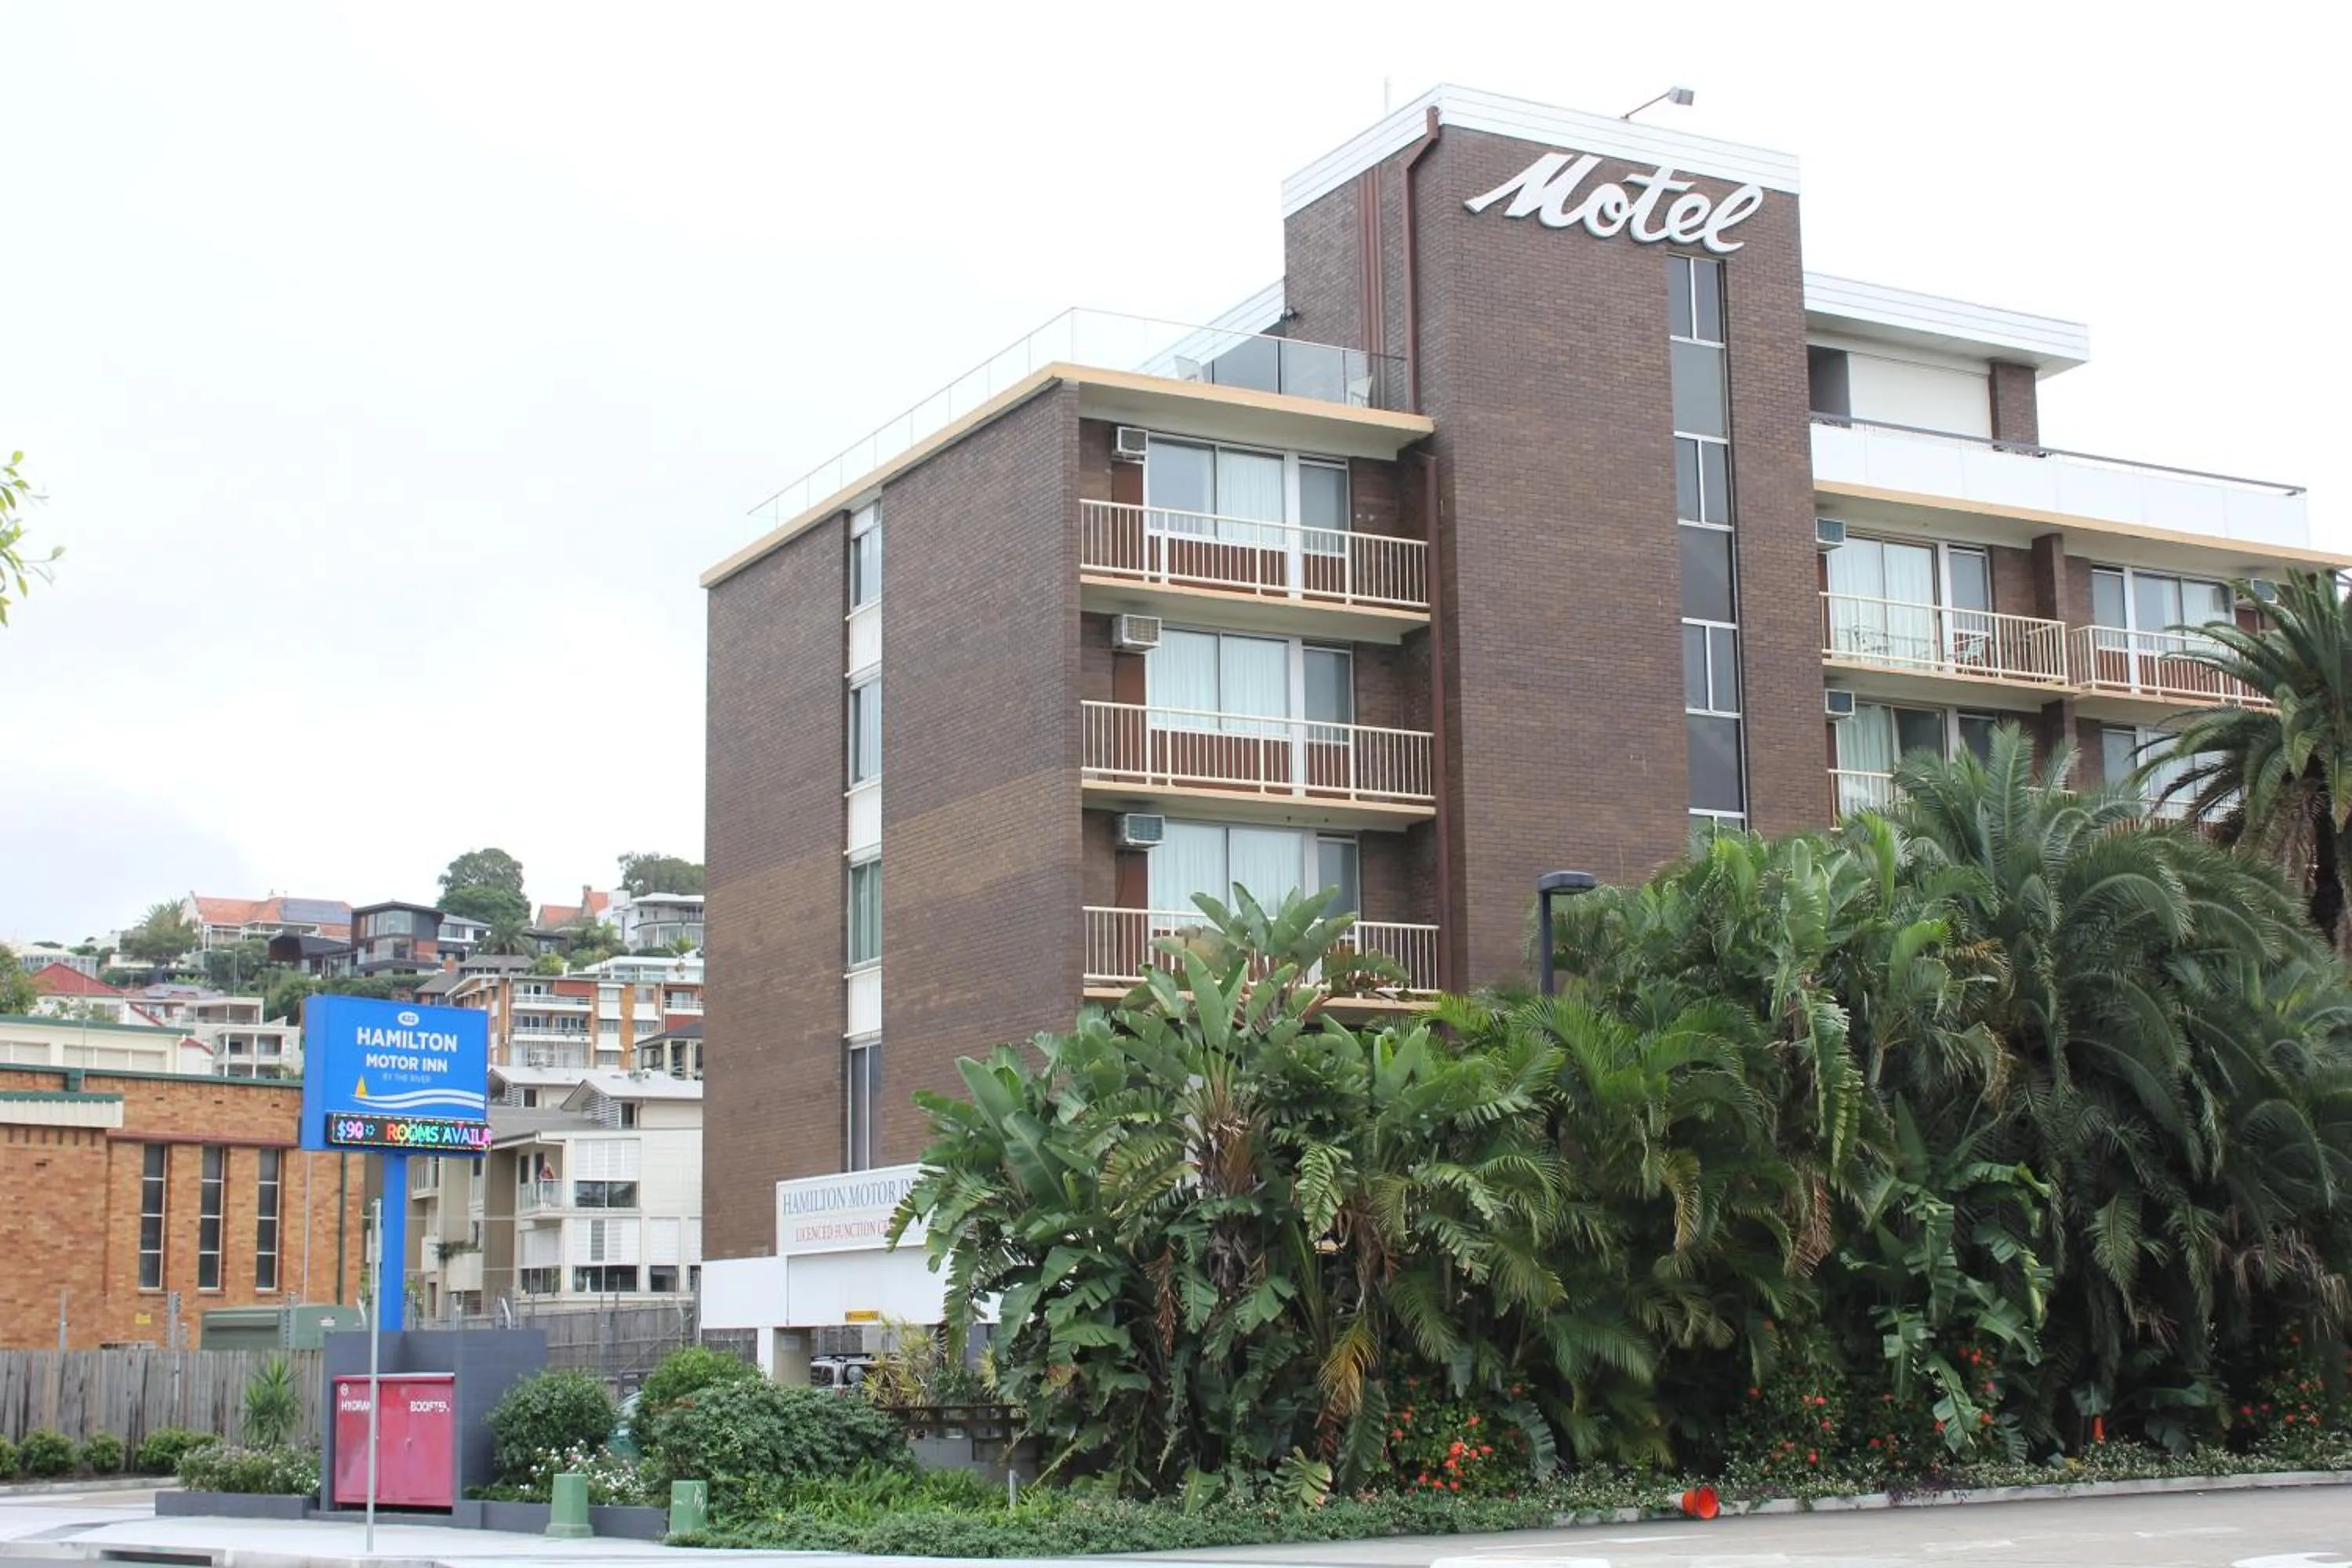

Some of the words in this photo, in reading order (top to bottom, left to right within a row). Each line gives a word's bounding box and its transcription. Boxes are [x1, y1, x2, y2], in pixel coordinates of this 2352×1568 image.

[1464, 152, 1763, 254] Motel
[357, 1027, 458, 1052] HAMILTON
[366, 1054, 419, 1072] MOTOR
[423, 1058, 448, 1073] INN
[386, 1121, 440, 1144] ROOMS
[783, 1185, 846, 1215] HAMILTON
[846, 1180, 898, 1208] MOTOR
[835, 1221, 876, 1240] FUNCTION
